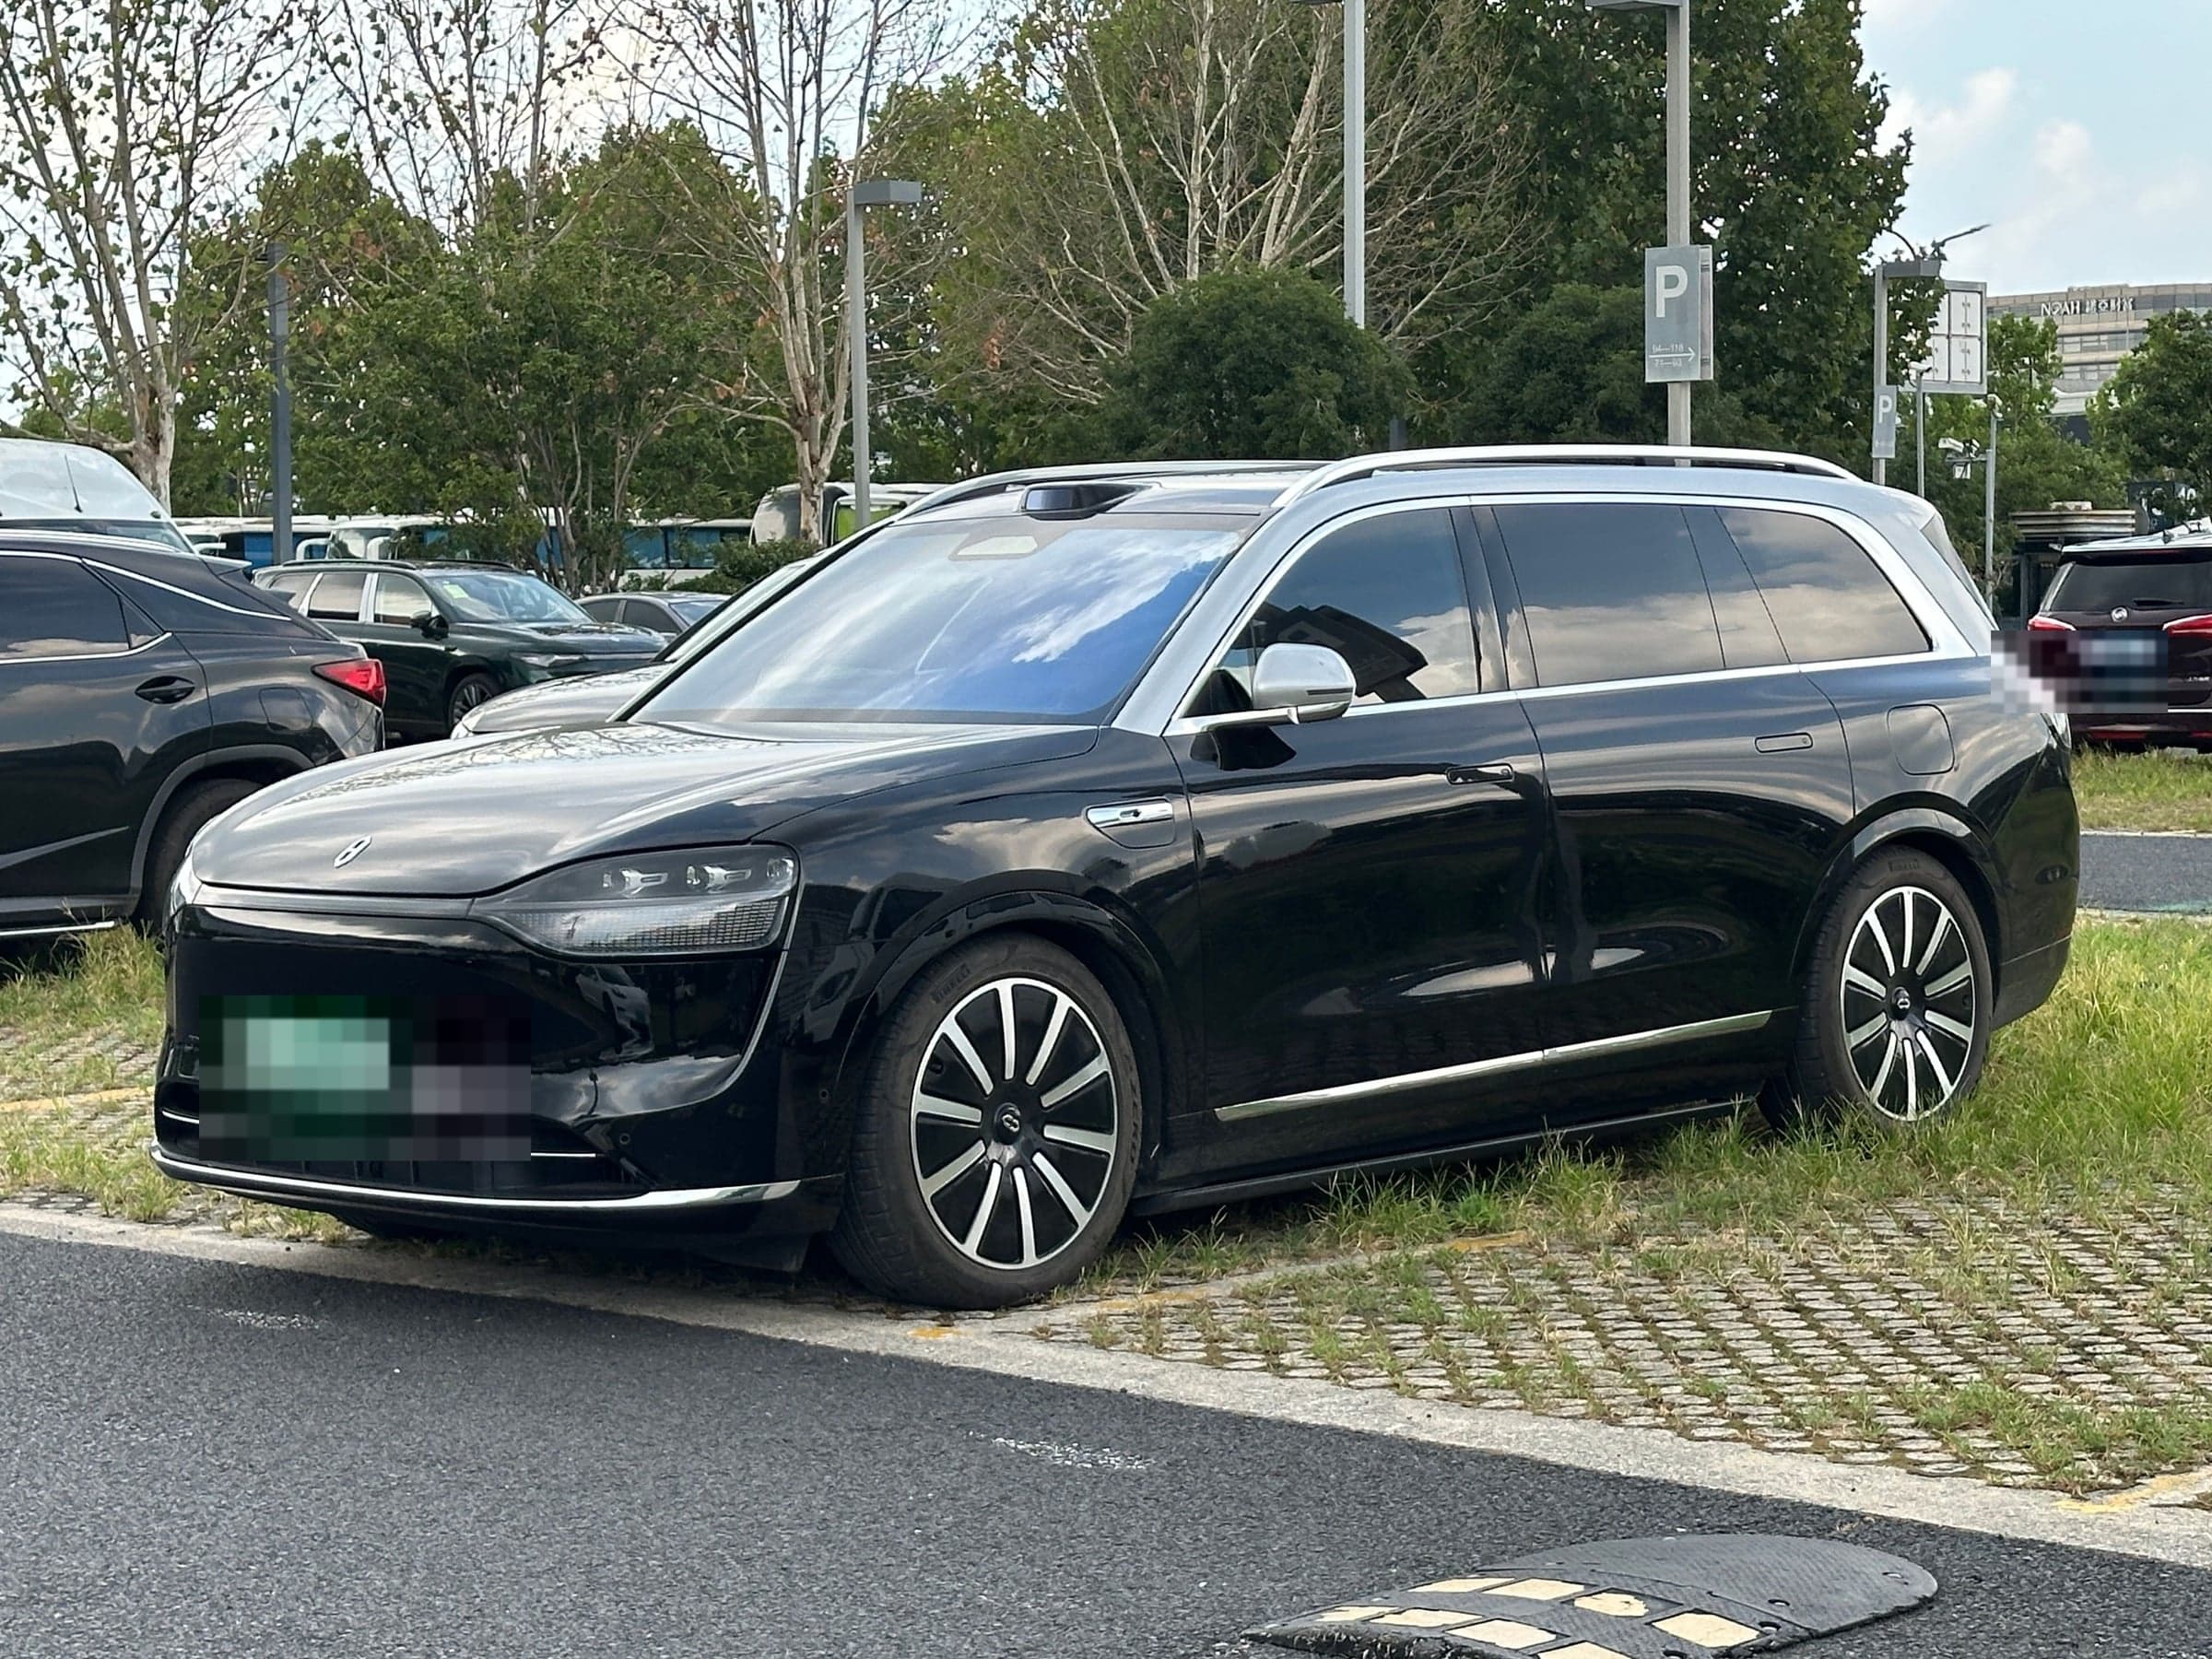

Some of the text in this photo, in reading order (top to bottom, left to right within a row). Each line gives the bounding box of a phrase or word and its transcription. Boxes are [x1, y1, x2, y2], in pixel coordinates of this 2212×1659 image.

[1656, 265, 1688, 317] P
[2041, 300, 2080, 316] NOAH
[1879, 394, 1892, 423] P
